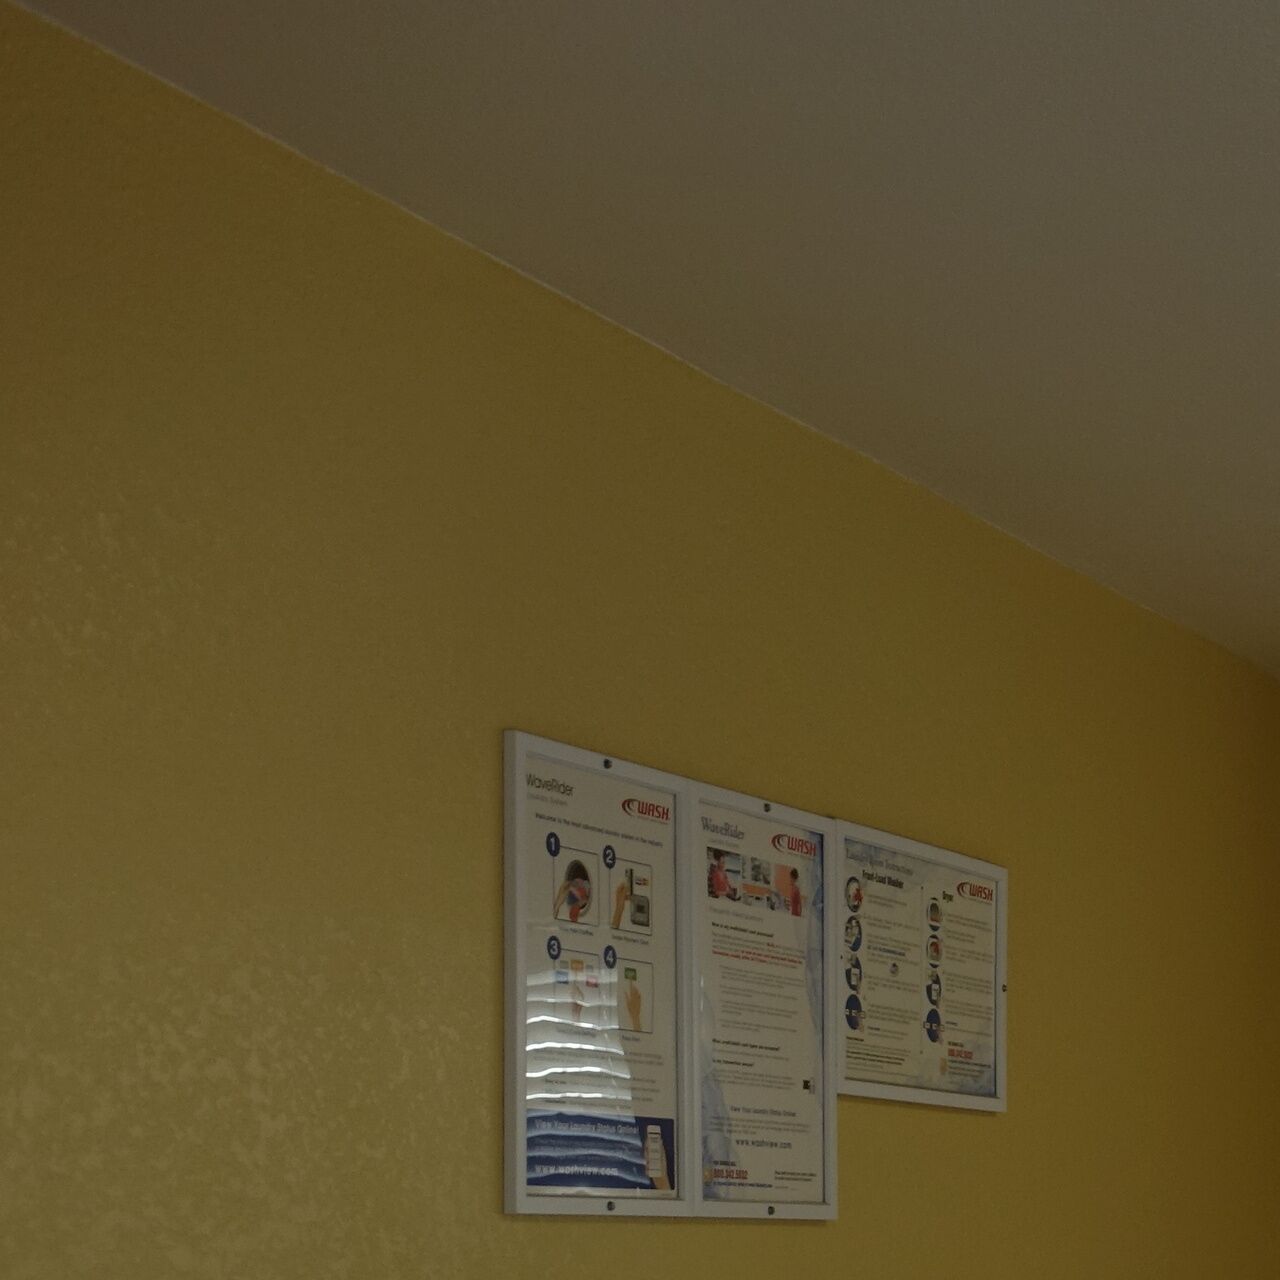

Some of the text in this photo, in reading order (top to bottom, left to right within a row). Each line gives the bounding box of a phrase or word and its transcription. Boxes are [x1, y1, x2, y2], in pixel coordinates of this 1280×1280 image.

[526, 773, 574, 797] WaveRider
[637, 800, 671, 821] WASH
[701, 816, 745, 840] WaveRider
[787, 835, 817, 857] WASH
[969, 883, 994, 902] WASH
[535, 1119, 552, 1129] View
[570, 1120, 596, 1133] Laundry
